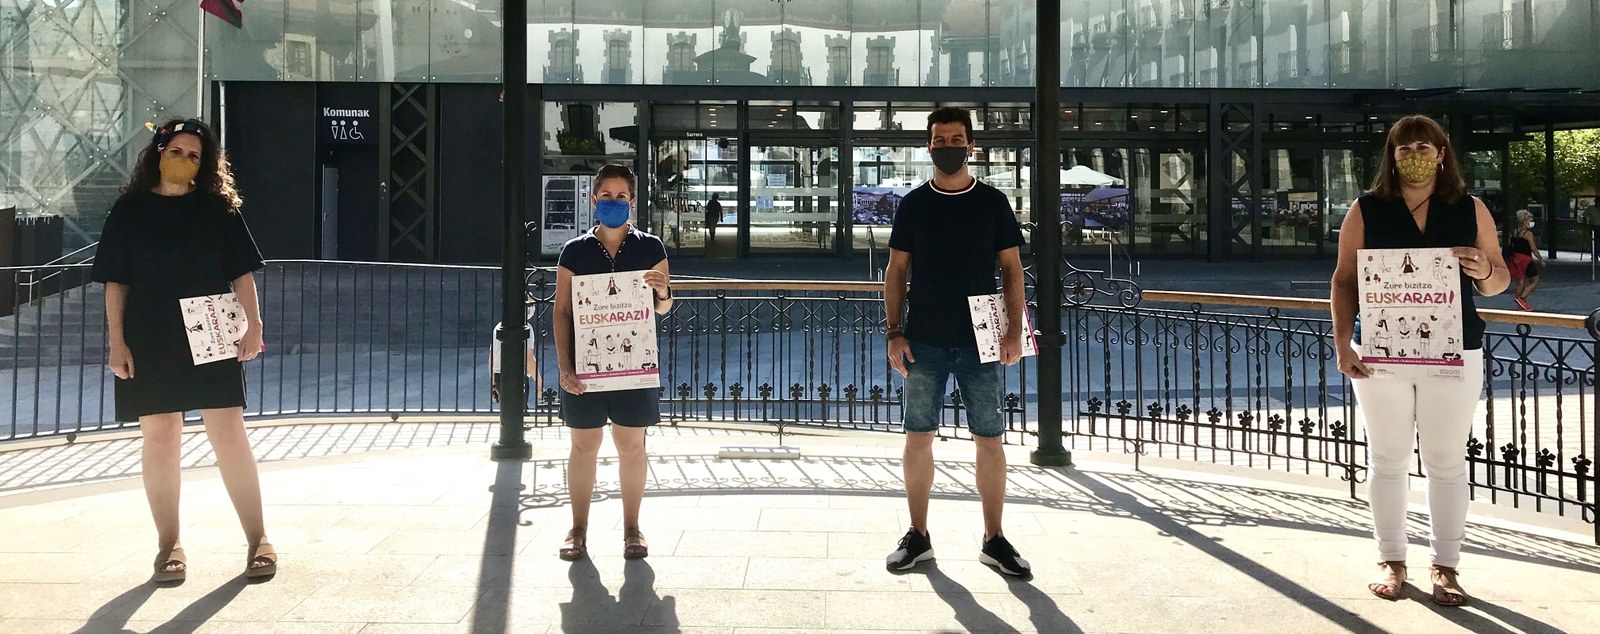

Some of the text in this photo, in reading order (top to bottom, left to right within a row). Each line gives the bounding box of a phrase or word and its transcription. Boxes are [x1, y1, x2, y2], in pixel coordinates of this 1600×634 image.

[323, 107, 370, 118] Komunak
[1383, 281, 1432, 289] Zure bizitza
[593, 301, 632, 311] Zure bizitza
